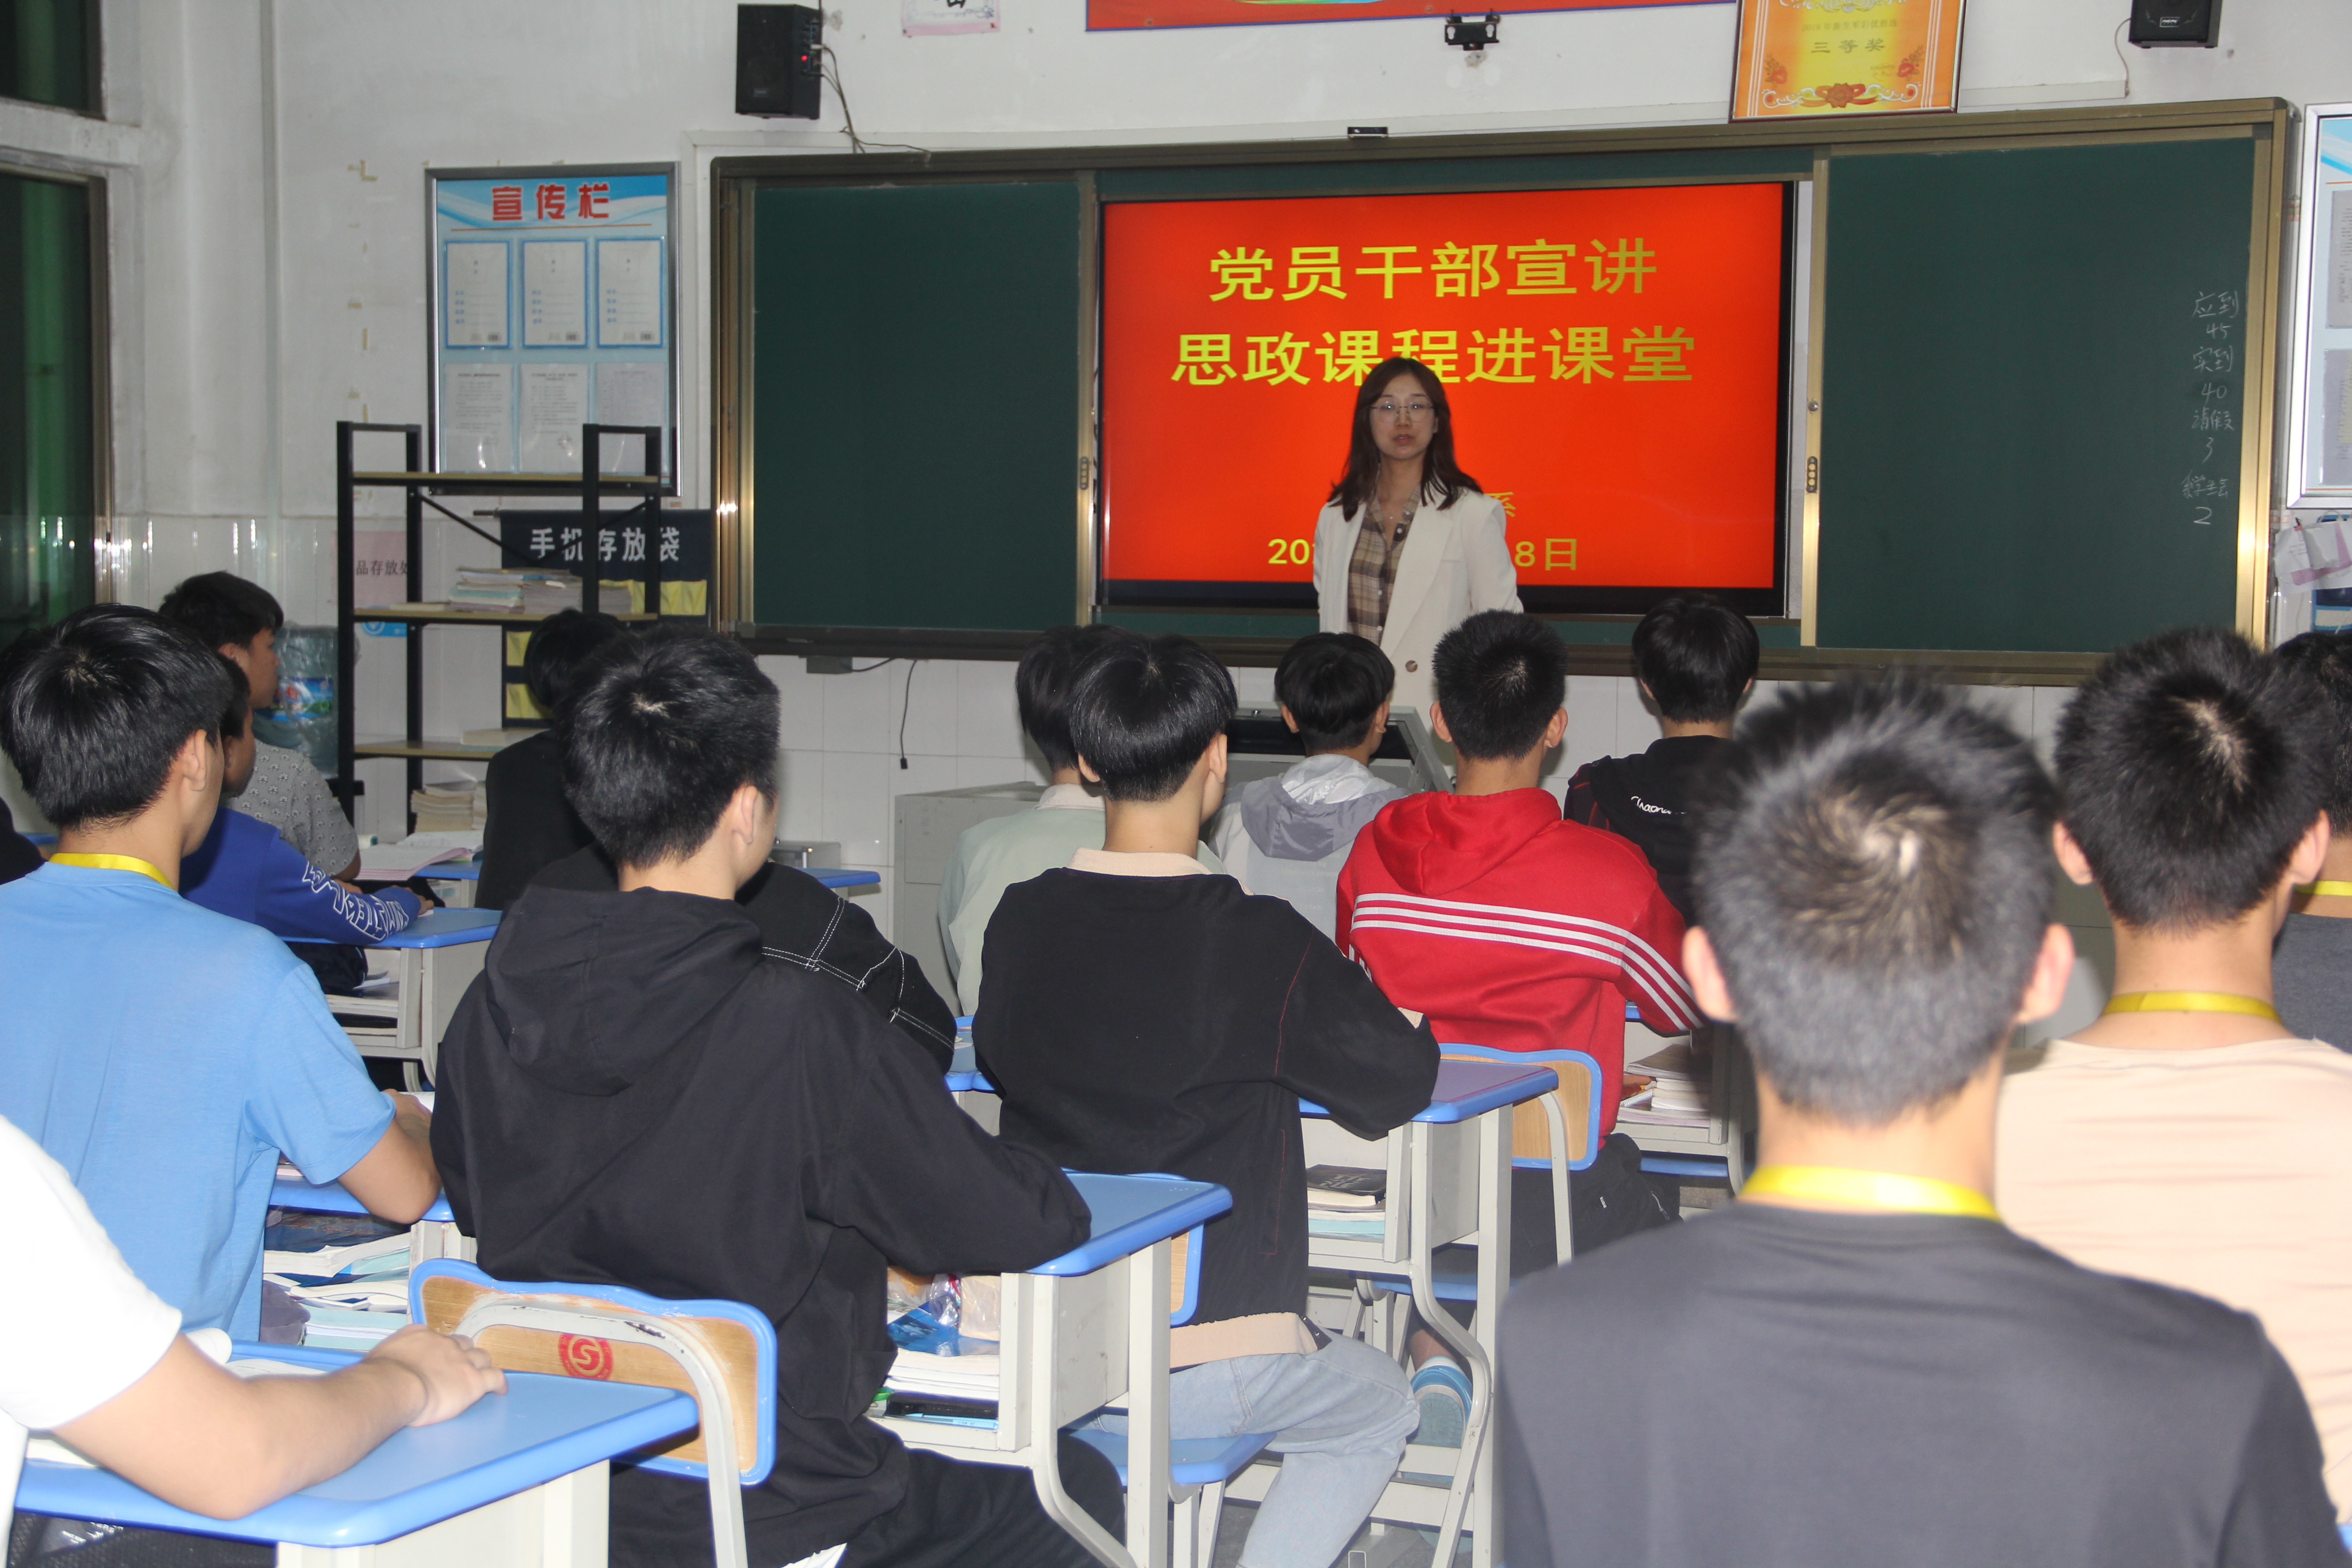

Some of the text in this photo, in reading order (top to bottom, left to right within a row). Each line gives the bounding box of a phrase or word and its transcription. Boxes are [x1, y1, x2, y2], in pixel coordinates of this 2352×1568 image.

[1811, 38, 1885, 54] 三等奖
[491, 182, 609, 221] 宣传栏
[1209, 237, 1657, 302] 党员干部宣讲
[2206, 323, 2231, 339] 45
[1171, 324, 1695, 387] 思政课程进课堂
[2193, 345, 2234, 372] 实到
[2201, 382, 2227, 405] 40
[2191, 406, 2234, 431] 请假
[2202, 437, 2215, 463] 3
[2193, 506, 2212, 525] 2
[530, 526, 680, 562] 手机存放袋
[1268, 538, 1315, 564] 20
